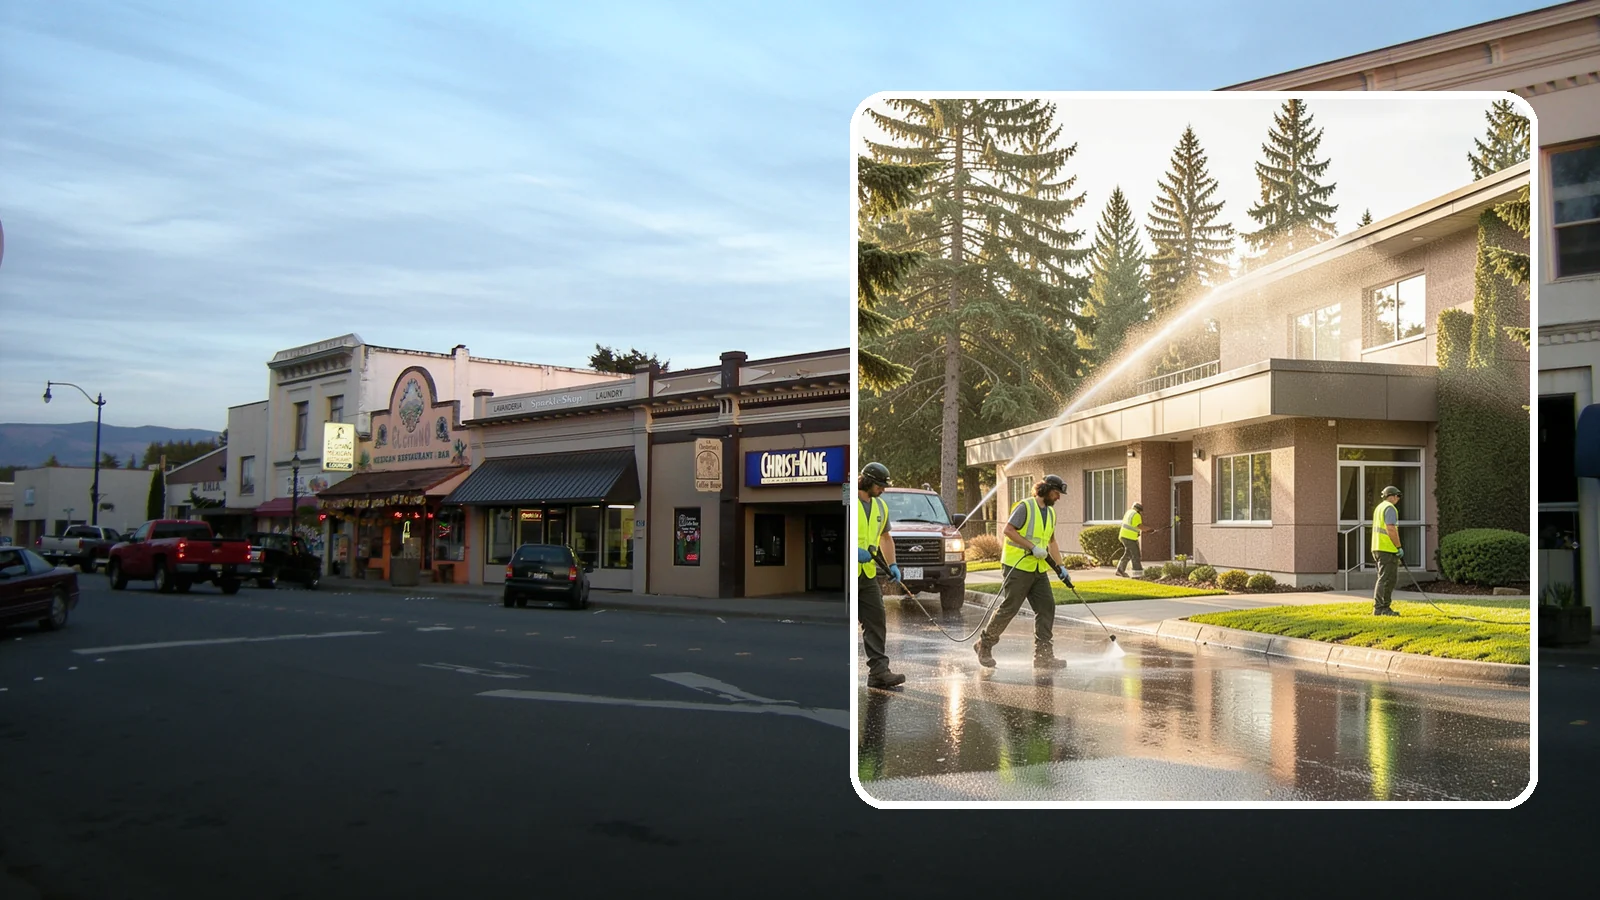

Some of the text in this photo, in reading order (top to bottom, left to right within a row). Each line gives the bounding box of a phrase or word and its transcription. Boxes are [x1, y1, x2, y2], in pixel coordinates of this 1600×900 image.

[595, 389, 624, 400] LAUNDRY
[493, 402, 522, 412] LAVANDERIA
[530, 394, 583, 408] Sparkle Shop
[373, 454, 396, 464] MEXICAN
[397, 451, 433, 462] RESTAURANT
[437, 450, 450, 459] BAR
[760, 450, 827, 478] CHRIST KING
[697, 481, 709, 489] Coffee
